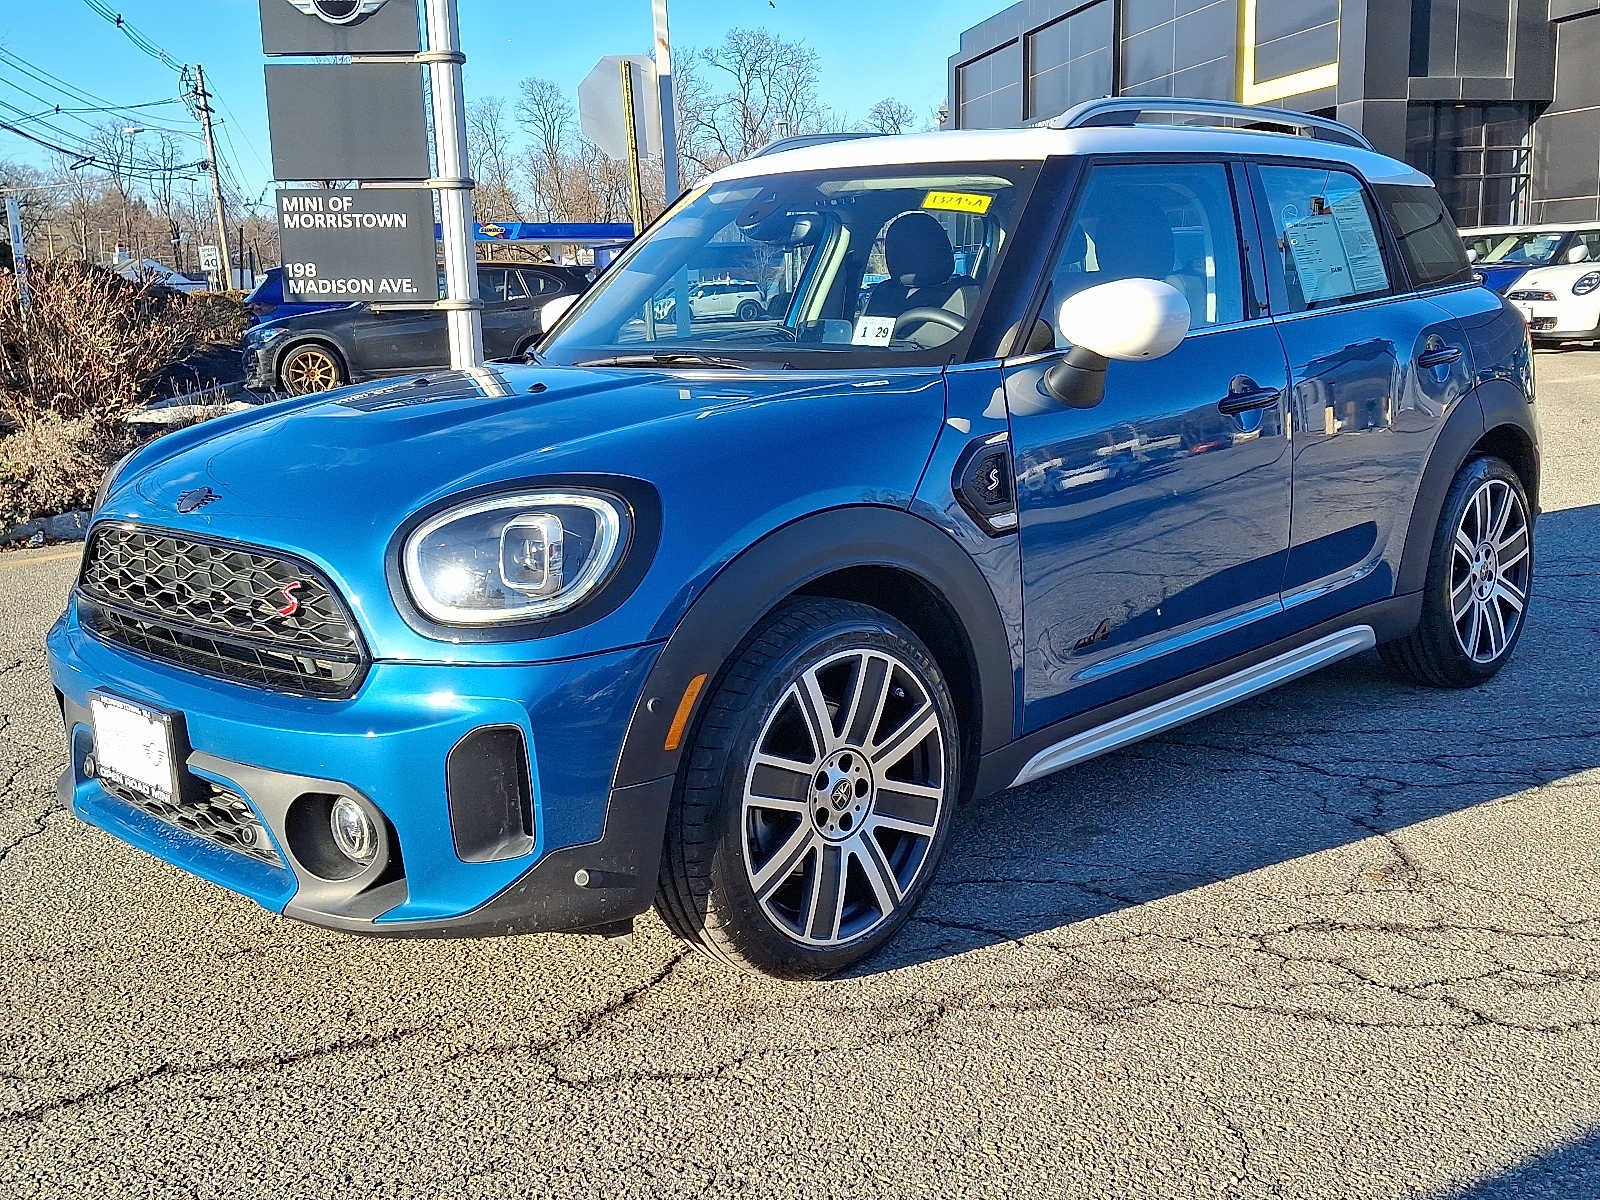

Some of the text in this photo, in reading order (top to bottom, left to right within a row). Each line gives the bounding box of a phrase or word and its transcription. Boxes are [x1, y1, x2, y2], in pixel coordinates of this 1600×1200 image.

[282, 196, 353, 212] MINI OF
[283, 212, 408, 229] MORRISTOWN
[204, 258, 218, 267] 40
[284, 262, 317, 278] 198
[288, 278, 418, 294] MADISON AVE.
[860, 326, 889, 338] 1 29
[987, 468, 999, 491] S
[277, 581, 302, 617] S
